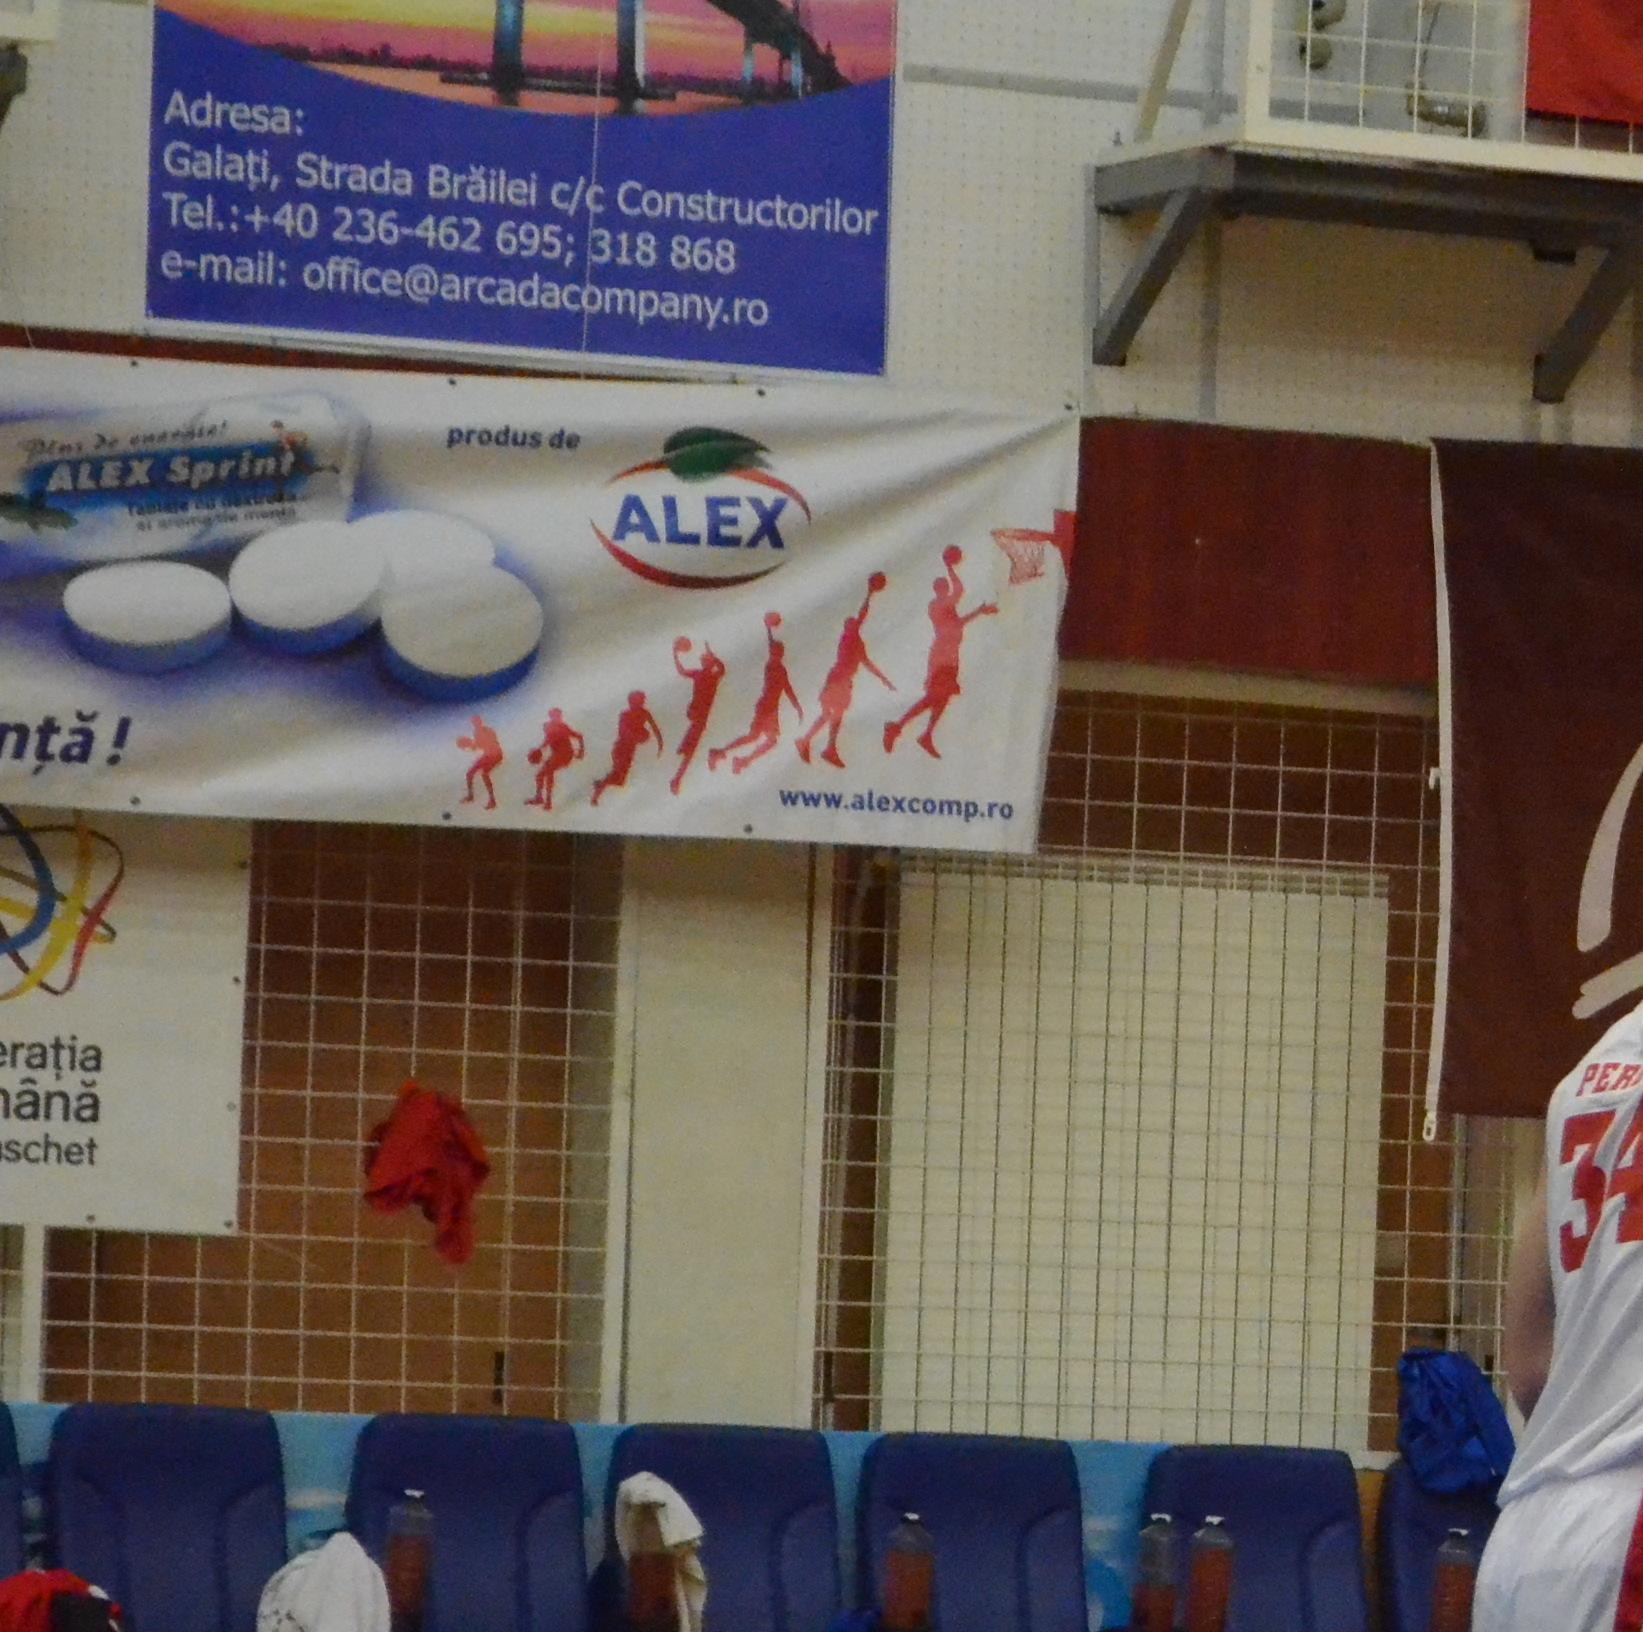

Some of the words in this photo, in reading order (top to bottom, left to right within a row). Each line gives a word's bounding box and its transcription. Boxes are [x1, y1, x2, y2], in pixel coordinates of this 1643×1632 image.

[163, 89, 304, 137] Adresa:
[296, 151, 413, 196] Strada
[428, 163, 537, 207] Brăilei
[551, 175, 604, 216] c/c
[617, 180, 880, 236] Constructorilor
[332, 206, 482, 253] 236-462
[496, 220, 574, 267] 695;
[590, 227, 657, 268] 318
[670, 235, 737, 276] 868
[161, 249, 287, 287] e-mail:
[303, 255, 769, 331] office@arcadacompany.ro
[446, 424, 543, 450] produs
[548, 425, 582, 450] de
[47, 457, 154, 492] ALEX
[611, 493, 788, 550] ALEX
[778, 787, 1015, 824] www.alexcomp.ro
[0, 1132, 98, 1166] schet
